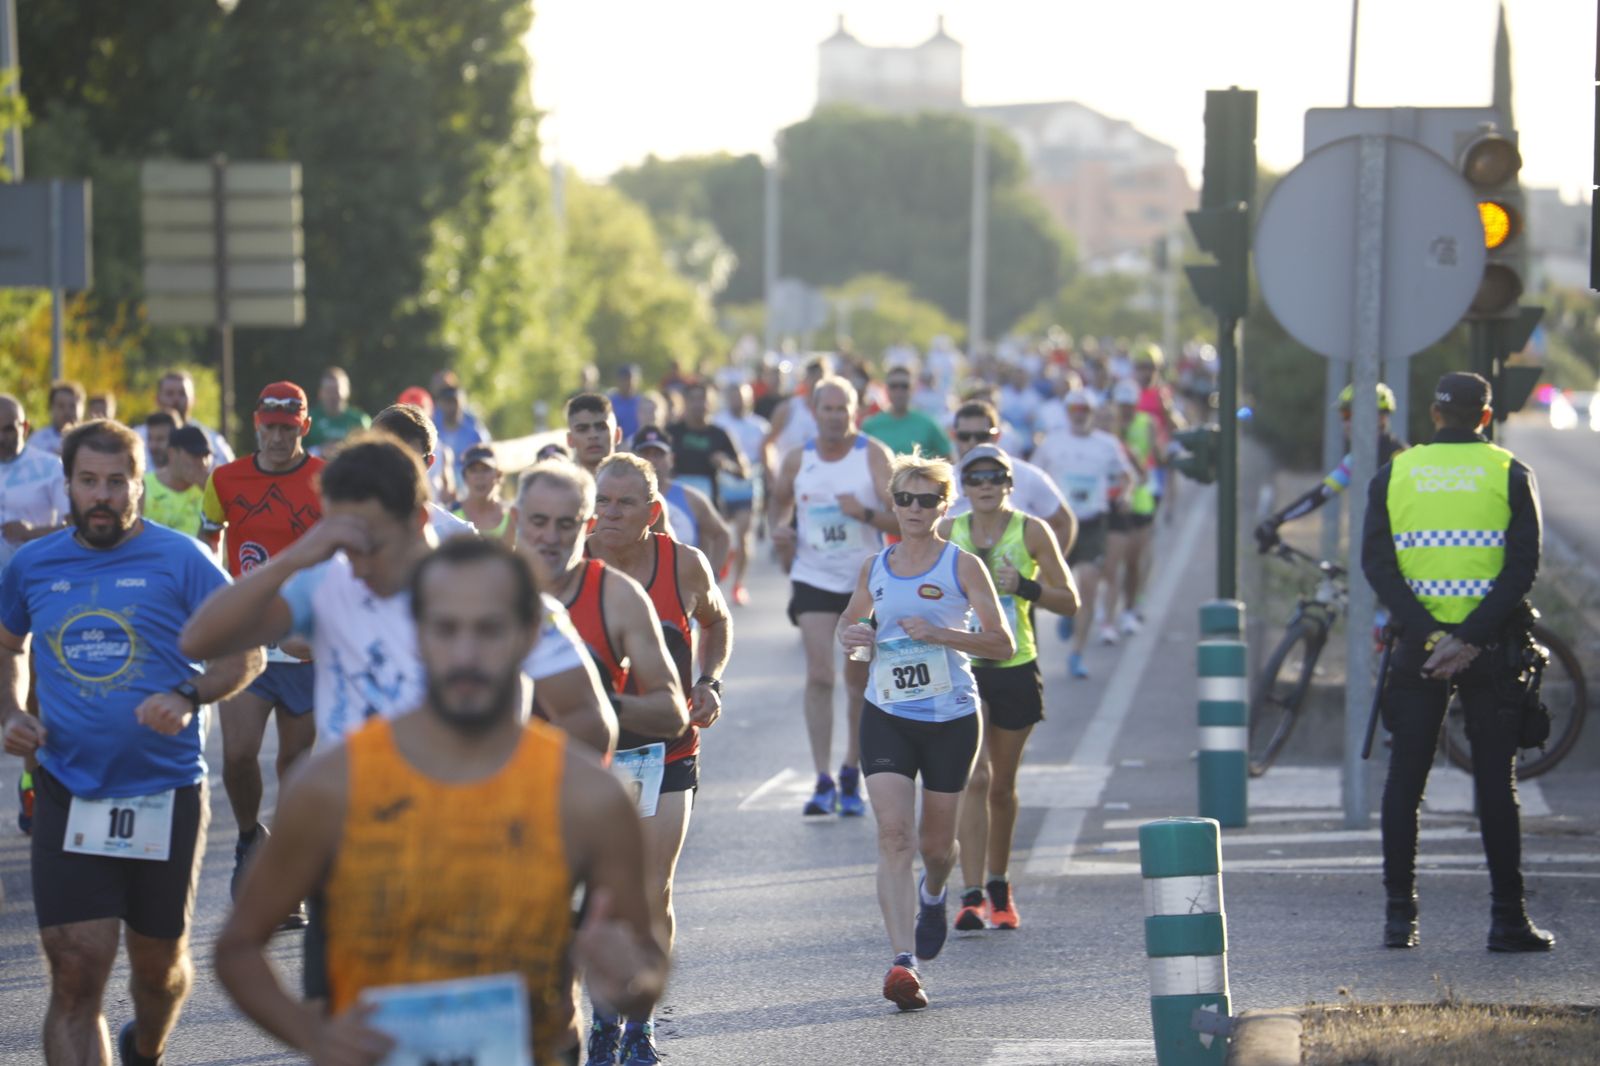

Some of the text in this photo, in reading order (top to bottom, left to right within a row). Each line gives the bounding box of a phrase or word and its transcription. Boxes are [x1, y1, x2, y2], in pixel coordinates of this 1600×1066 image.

[1417, 480, 1477, 492] LOCAL
[893, 663, 930, 689] 320
[108, 806, 135, 839] 10
